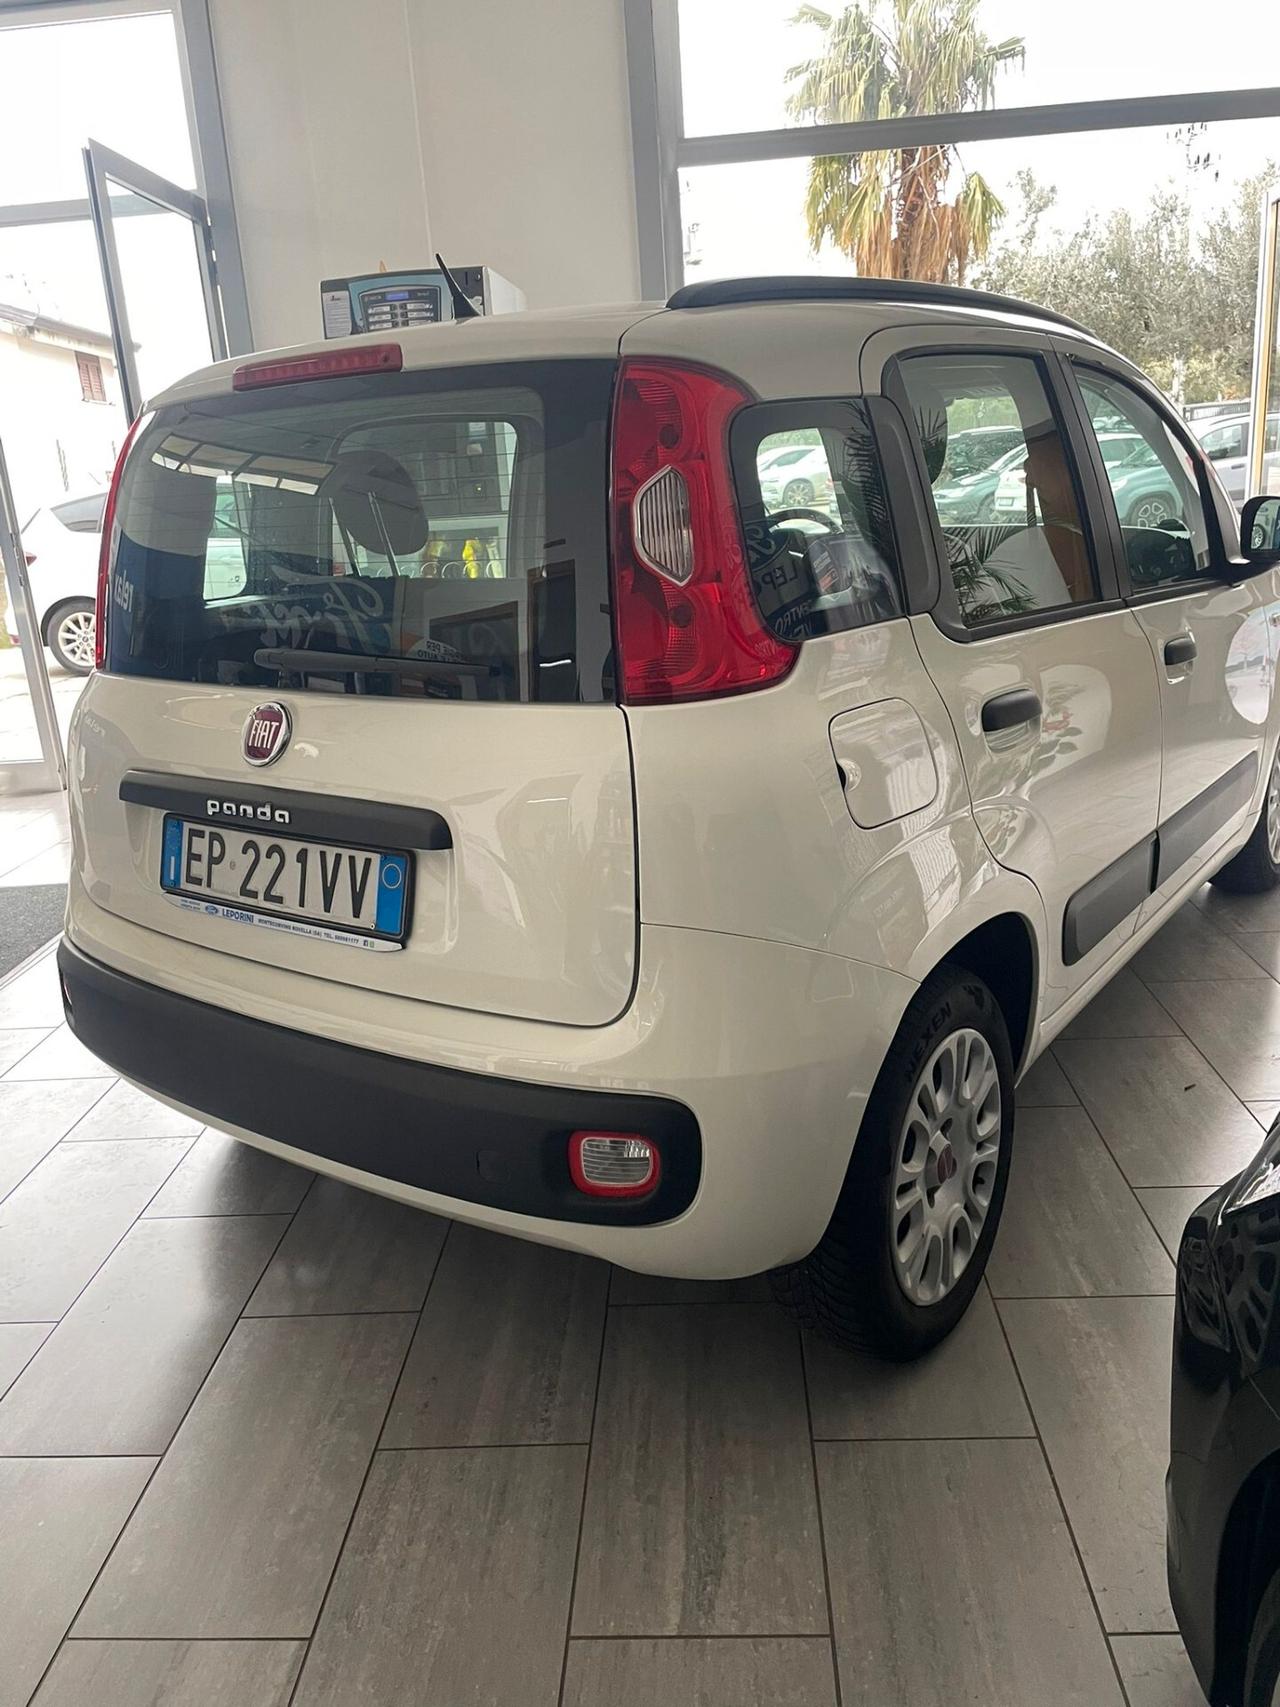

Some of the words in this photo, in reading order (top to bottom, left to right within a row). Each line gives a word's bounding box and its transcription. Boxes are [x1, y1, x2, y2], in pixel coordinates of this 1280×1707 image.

[248, 719, 280, 749] FIAT
[206, 799, 291, 824] panda
[185, 828, 226, 889] EP
[239, 839, 373, 919] 221VV
[221, 907, 255, 924] LEPORINI
[904, 1001, 952, 1083] NEXEN
